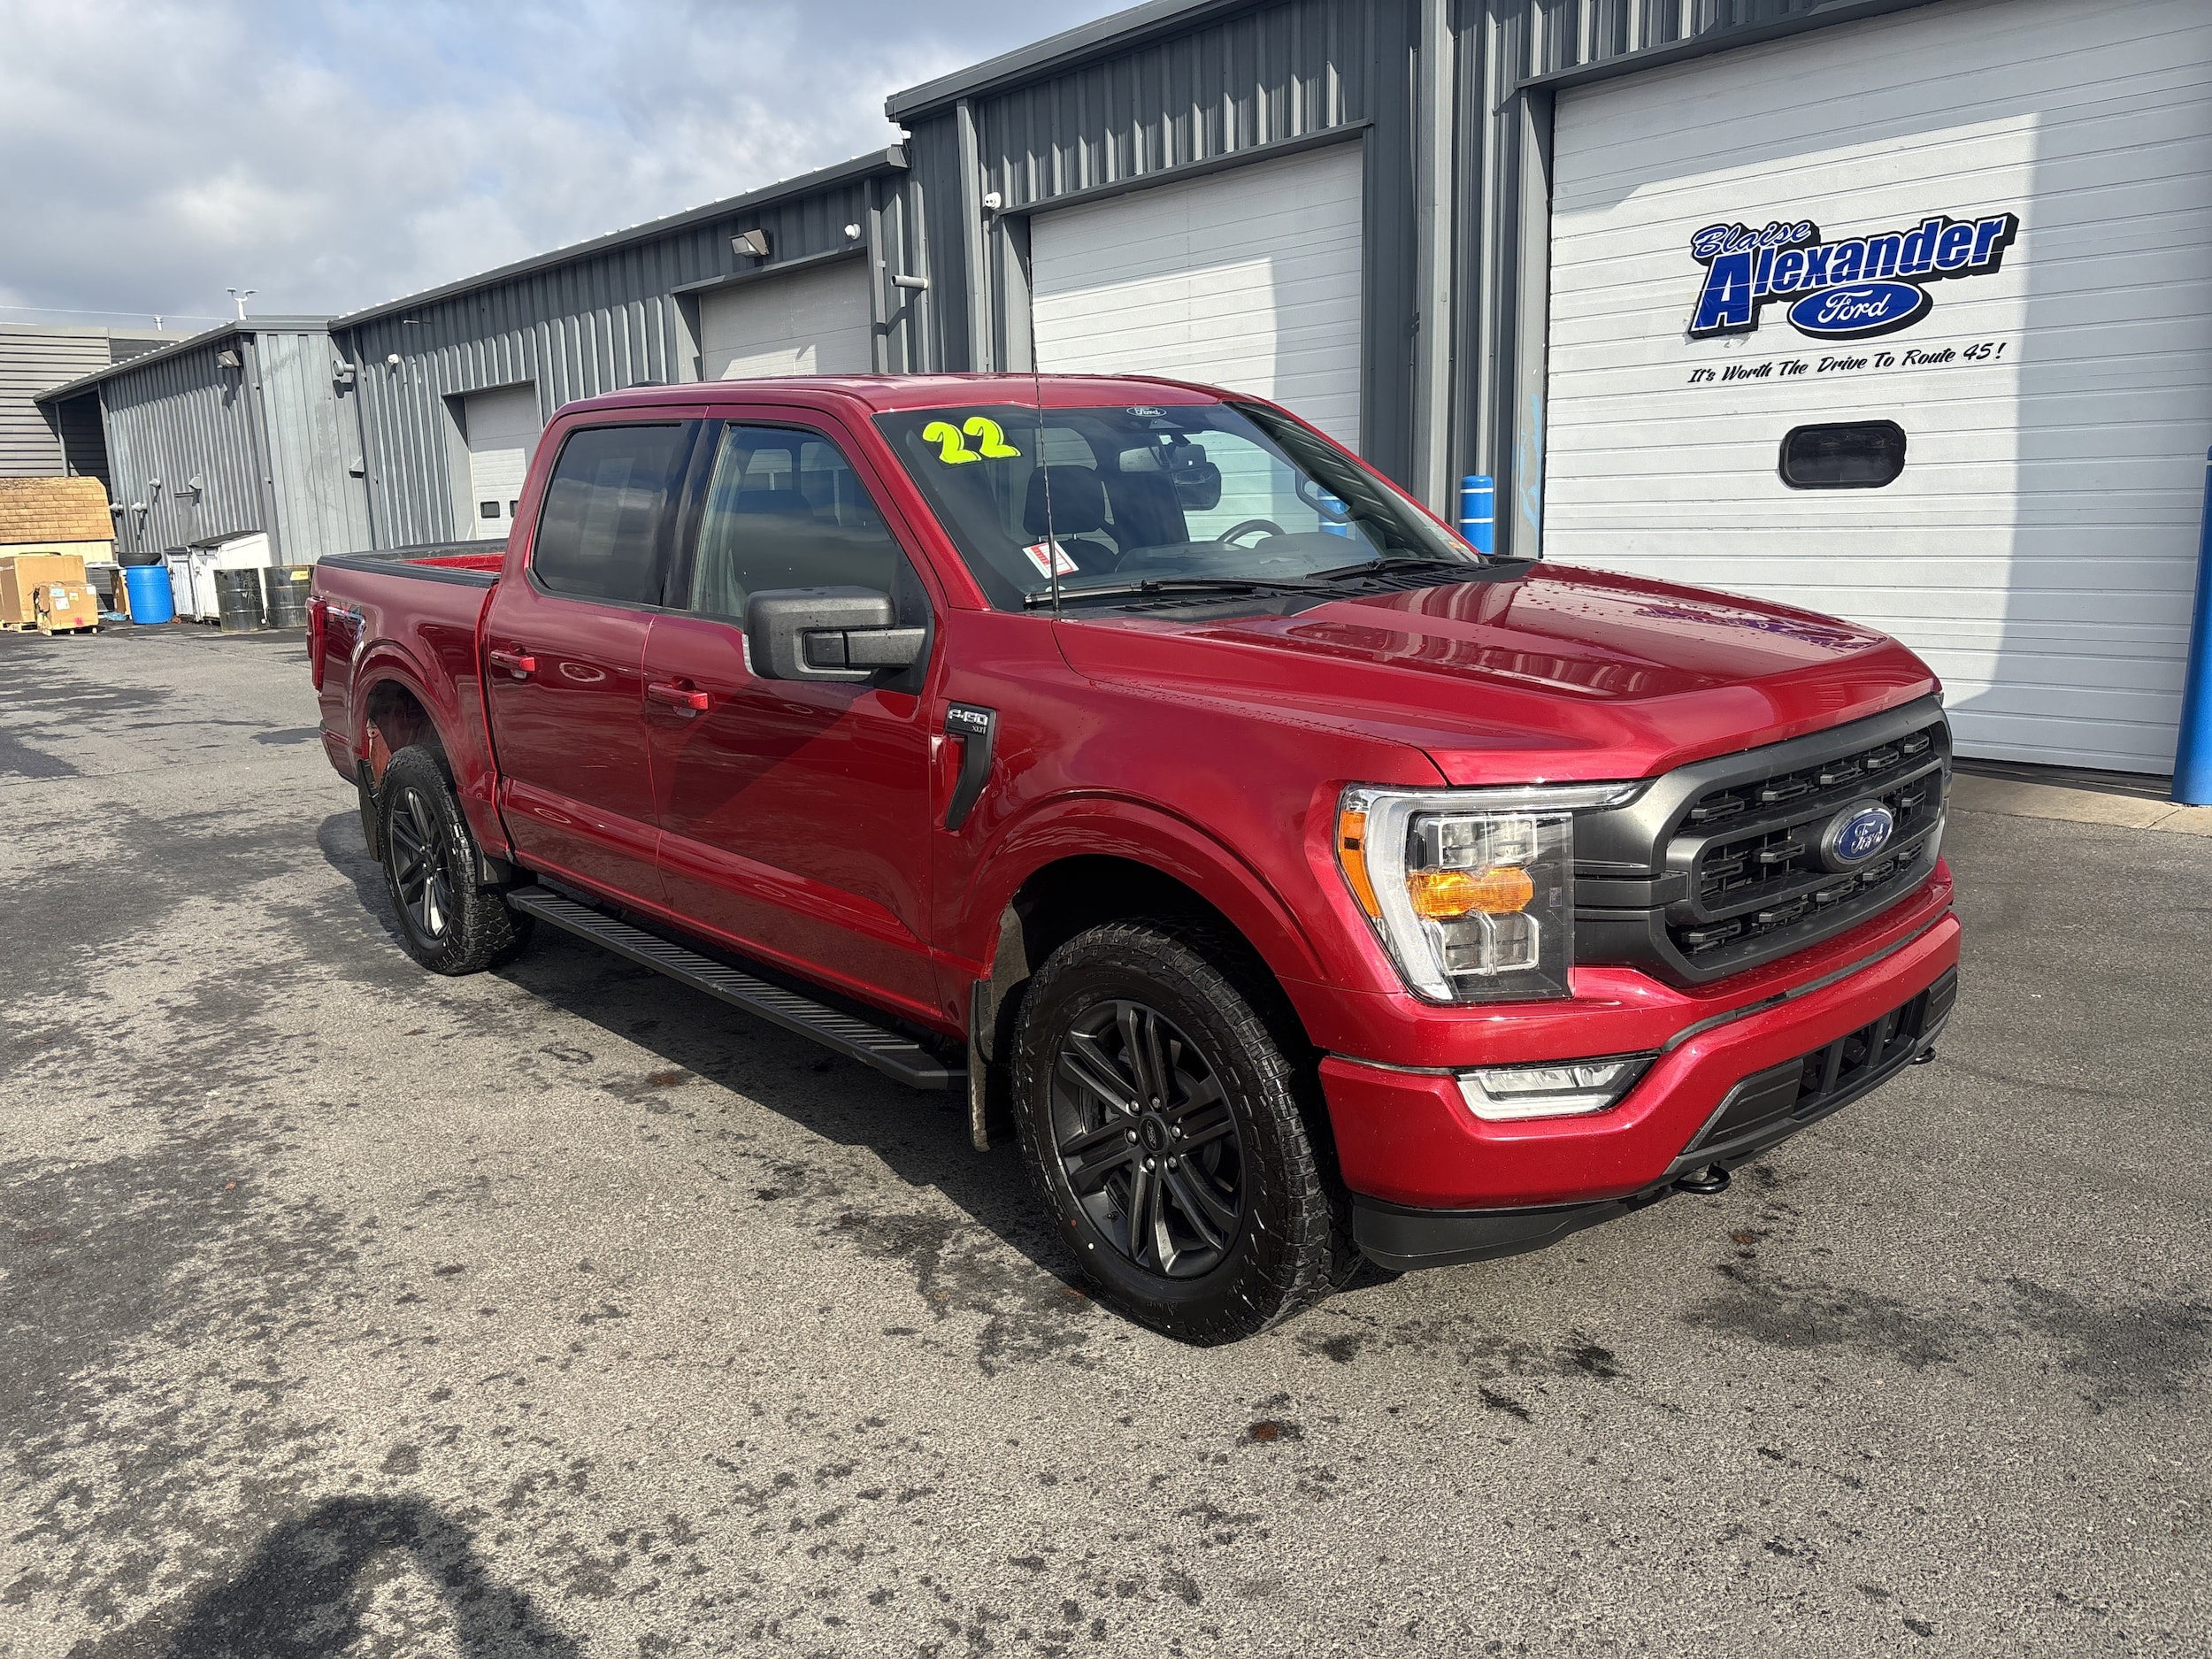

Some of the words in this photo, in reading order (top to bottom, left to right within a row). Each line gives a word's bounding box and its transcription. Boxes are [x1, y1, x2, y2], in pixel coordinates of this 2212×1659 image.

[1693, 220, 1811, 257] Blaise
[1691, 214, 2012, 333] Alexander
[1816, 290, 1891, 323] Ford
[1687, 368, 1716, 383] It's
[1721, 361, 1773, 381] Worth
[1778, 359, 1809, 376] The
[1817, 356, 1868, 373] Drive
[1874, 351, 1895, 368] To
[1901, 348, 1956, 366] Route
[922, 416, 1021, 465] 22
[1850, 819, 1884, 854] Ford
